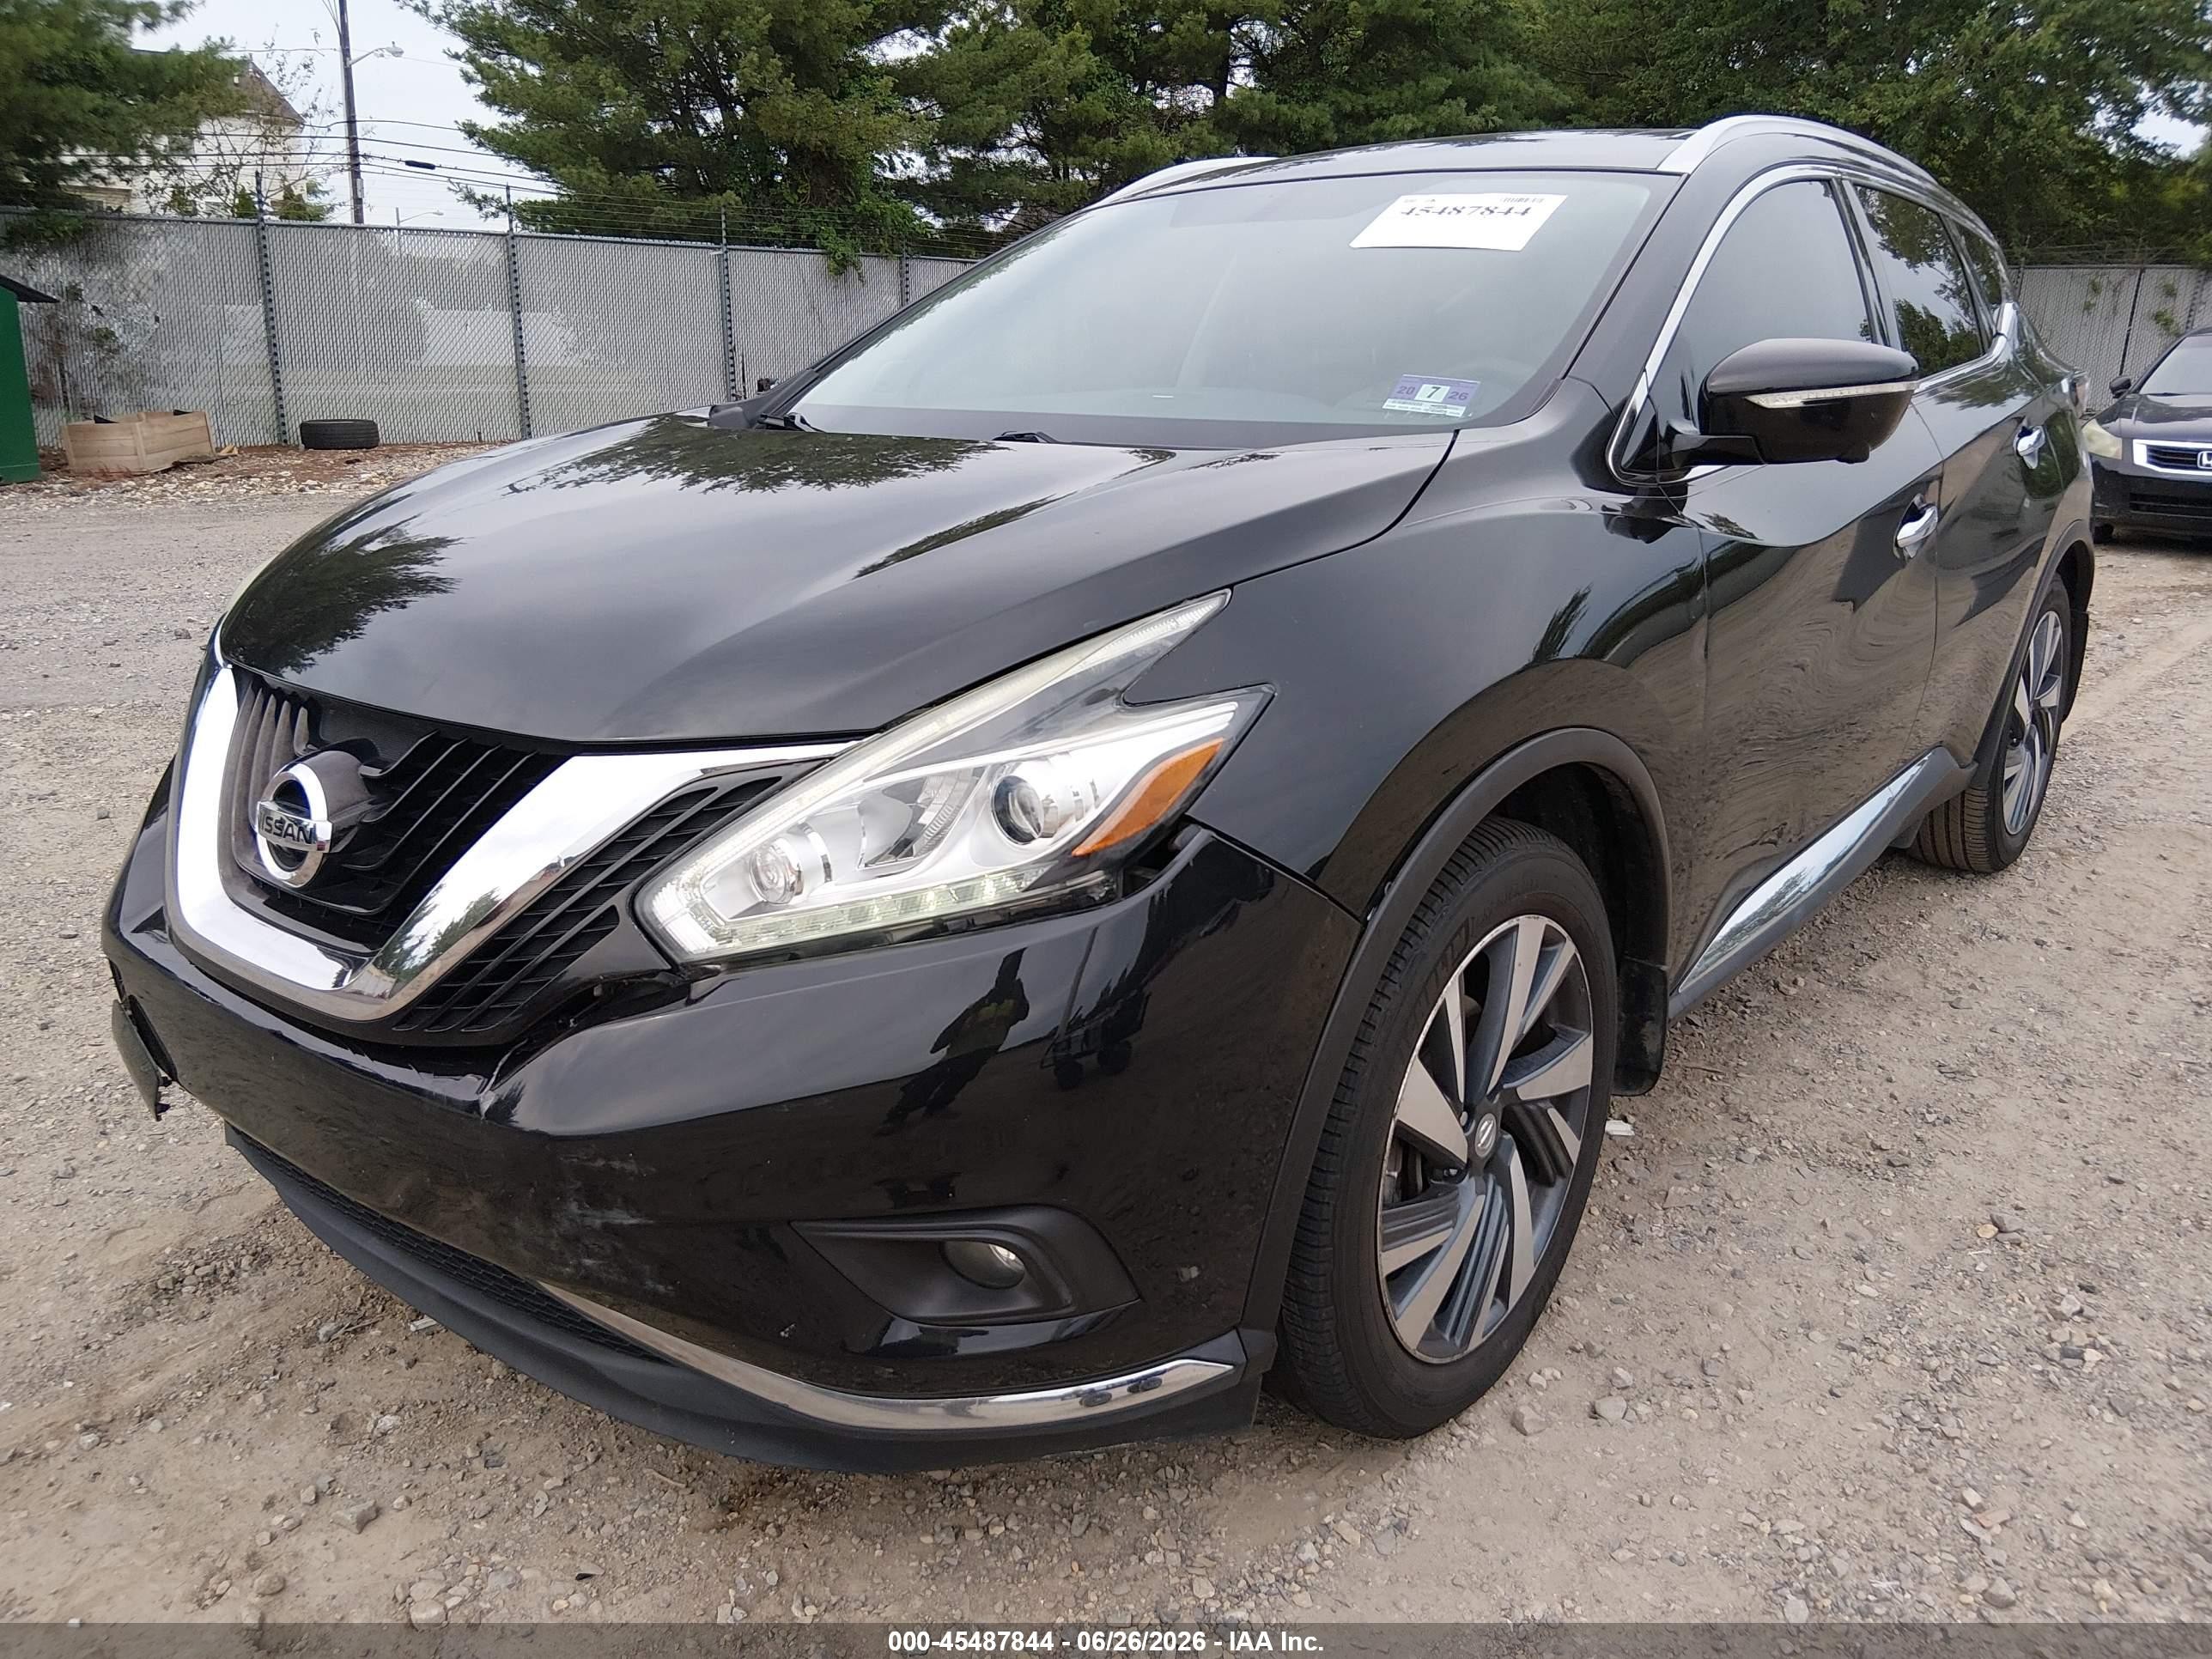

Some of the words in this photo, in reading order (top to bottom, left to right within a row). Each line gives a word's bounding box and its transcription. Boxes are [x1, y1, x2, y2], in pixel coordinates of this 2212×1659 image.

[1401, 205, 1532, 216] 45487844
[1396, 386, 1416, 395] 20
[1426, 386, 1442, 398] 7
[1447, 391, 1469, 401] 26
